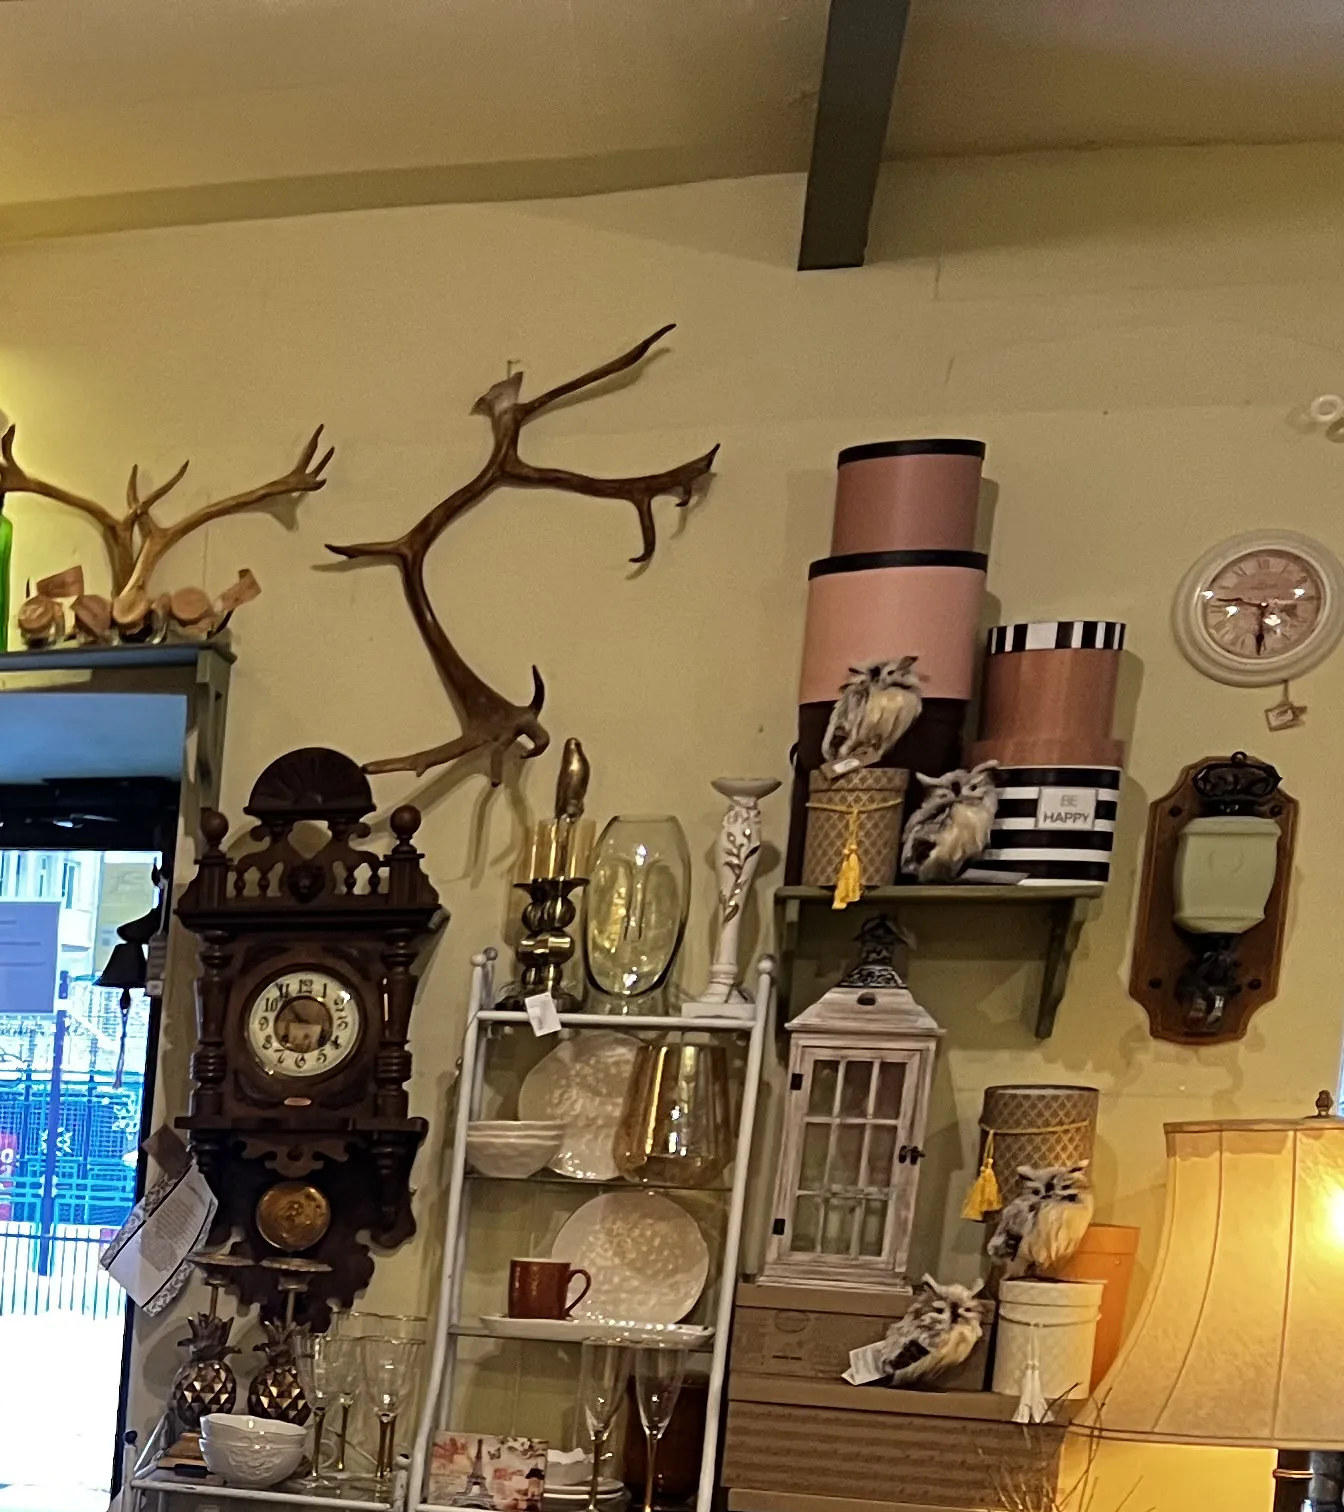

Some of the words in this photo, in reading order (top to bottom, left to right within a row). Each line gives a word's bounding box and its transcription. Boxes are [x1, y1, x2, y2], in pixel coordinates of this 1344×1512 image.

[1061, 794, 1079, 808] BE
[1043, 812, 1090, 824] HAPPY
[263, 998, 278, 1013] 10
